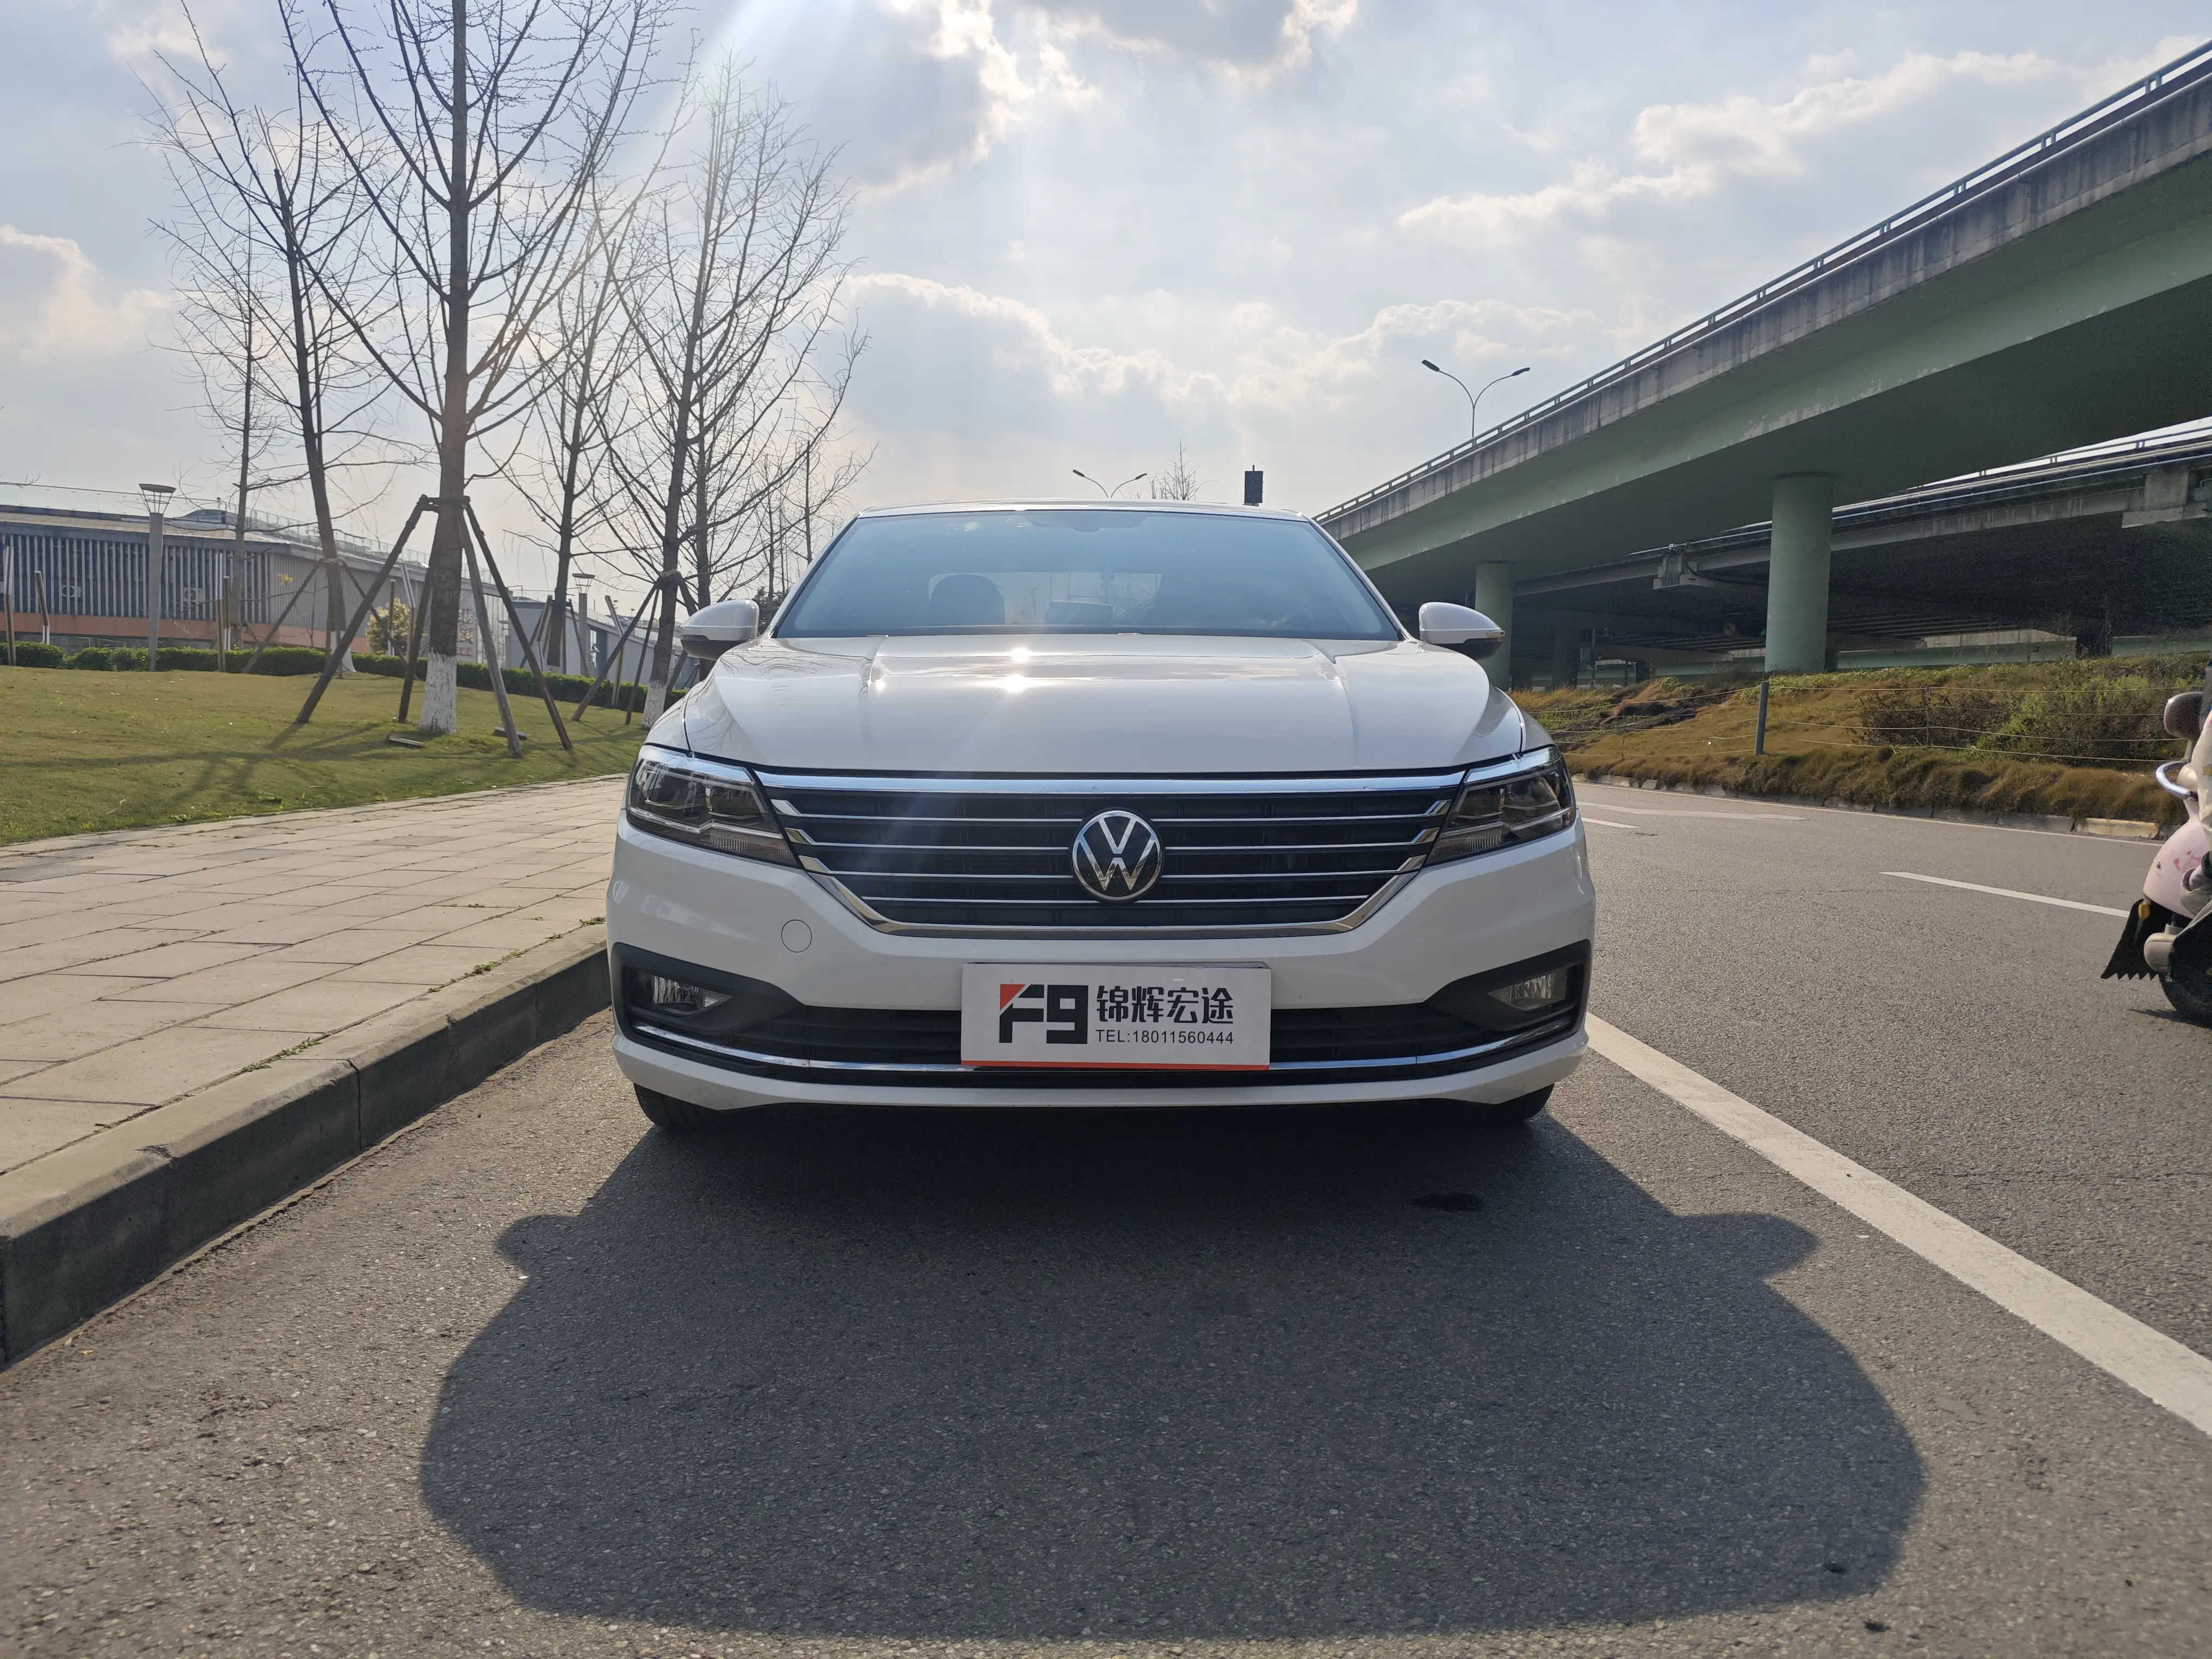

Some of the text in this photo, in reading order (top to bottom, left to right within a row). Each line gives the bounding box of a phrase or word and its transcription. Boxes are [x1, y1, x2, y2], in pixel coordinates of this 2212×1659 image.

[1096, 985, 1234, 1024] 锦辉宏途
[1095, 1029, 1233, 1044] TEL:18011560444
